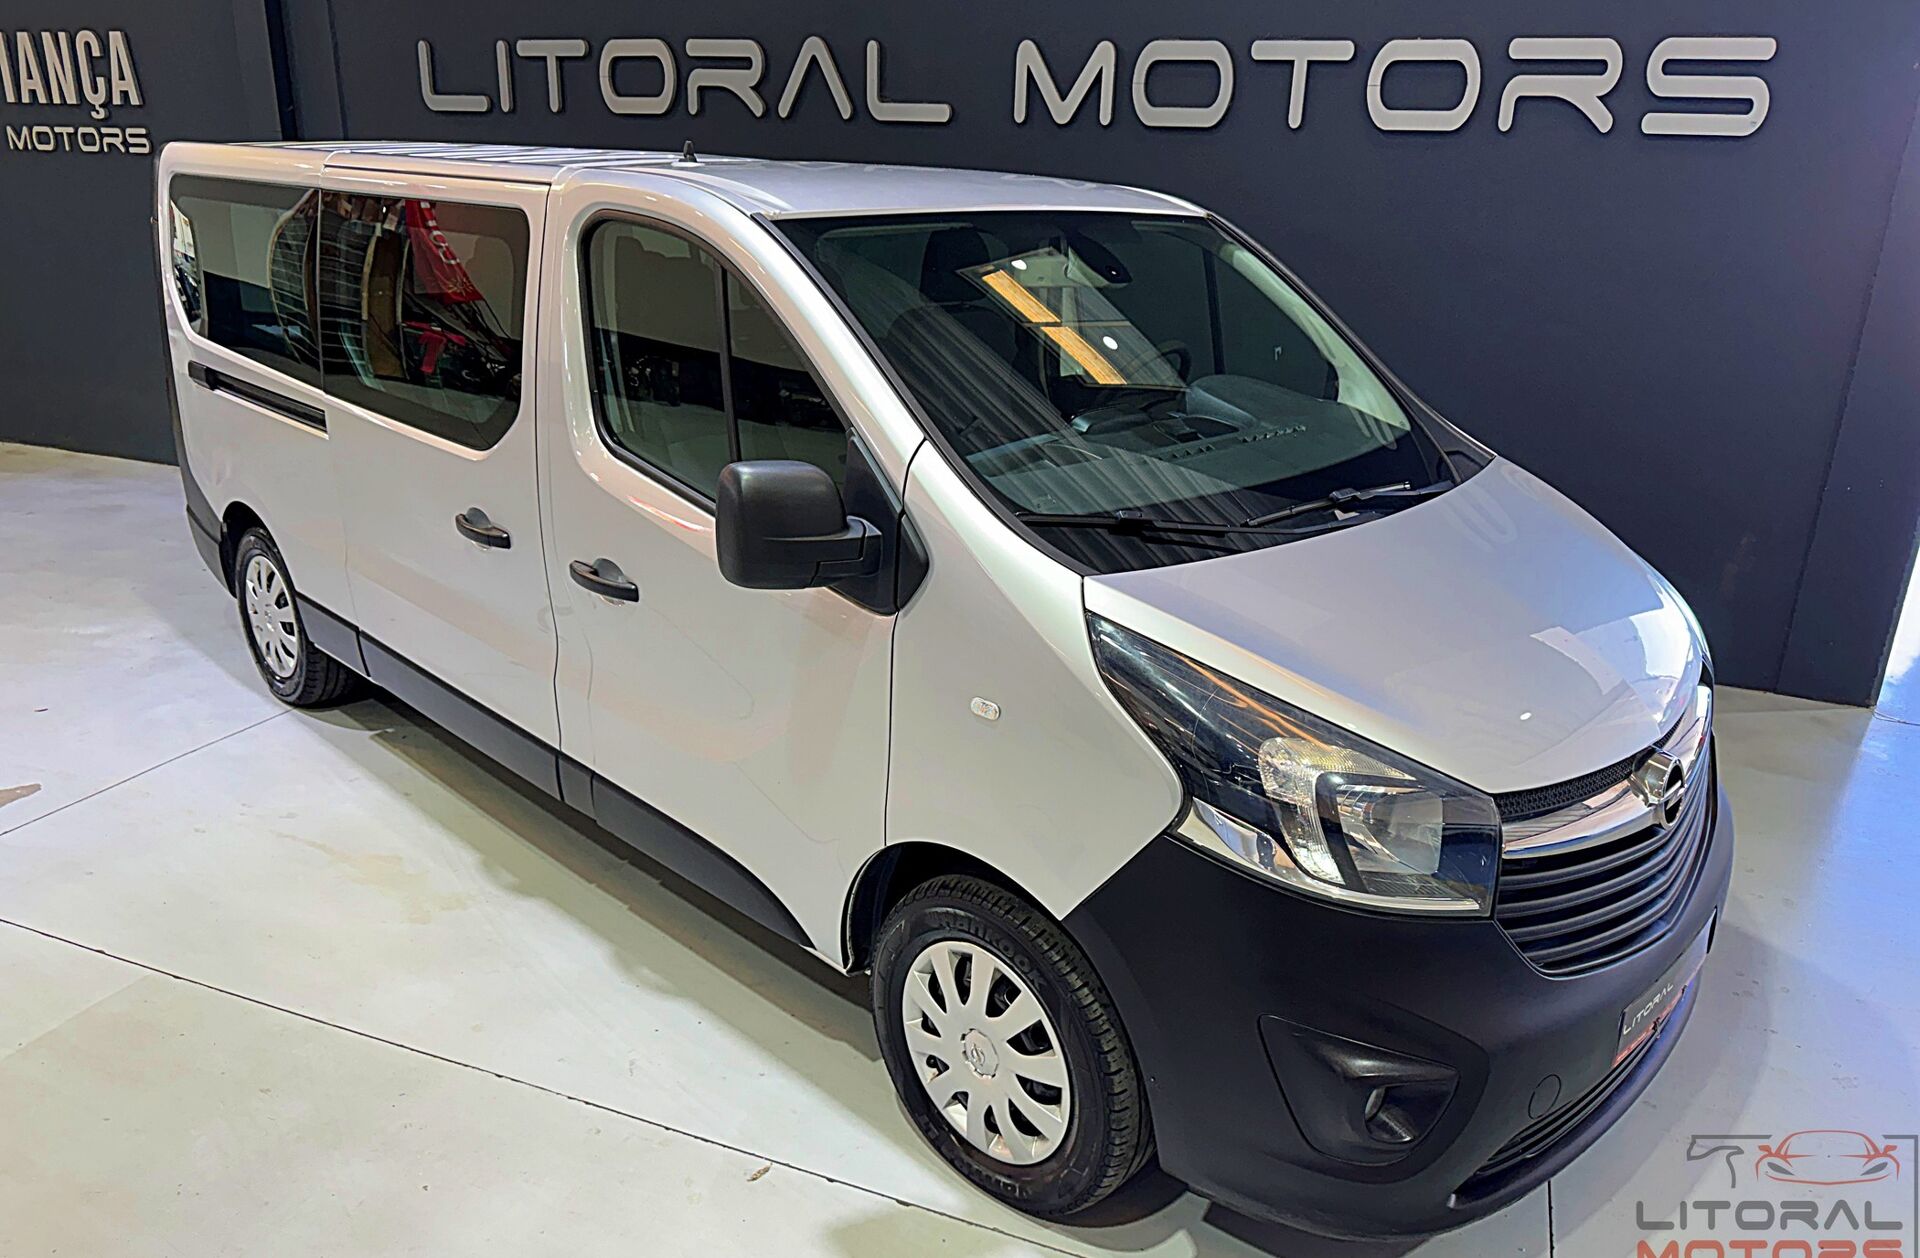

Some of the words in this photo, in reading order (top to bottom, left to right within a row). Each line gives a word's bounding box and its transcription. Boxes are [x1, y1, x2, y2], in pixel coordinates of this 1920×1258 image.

[417, 35, 953, 123] LITORAL
[1013, 36, 1778, 137] MOTORS
[6, 125, 152, 154] MOTORS
[1623, 982, 1674, 1035] LITORAL
